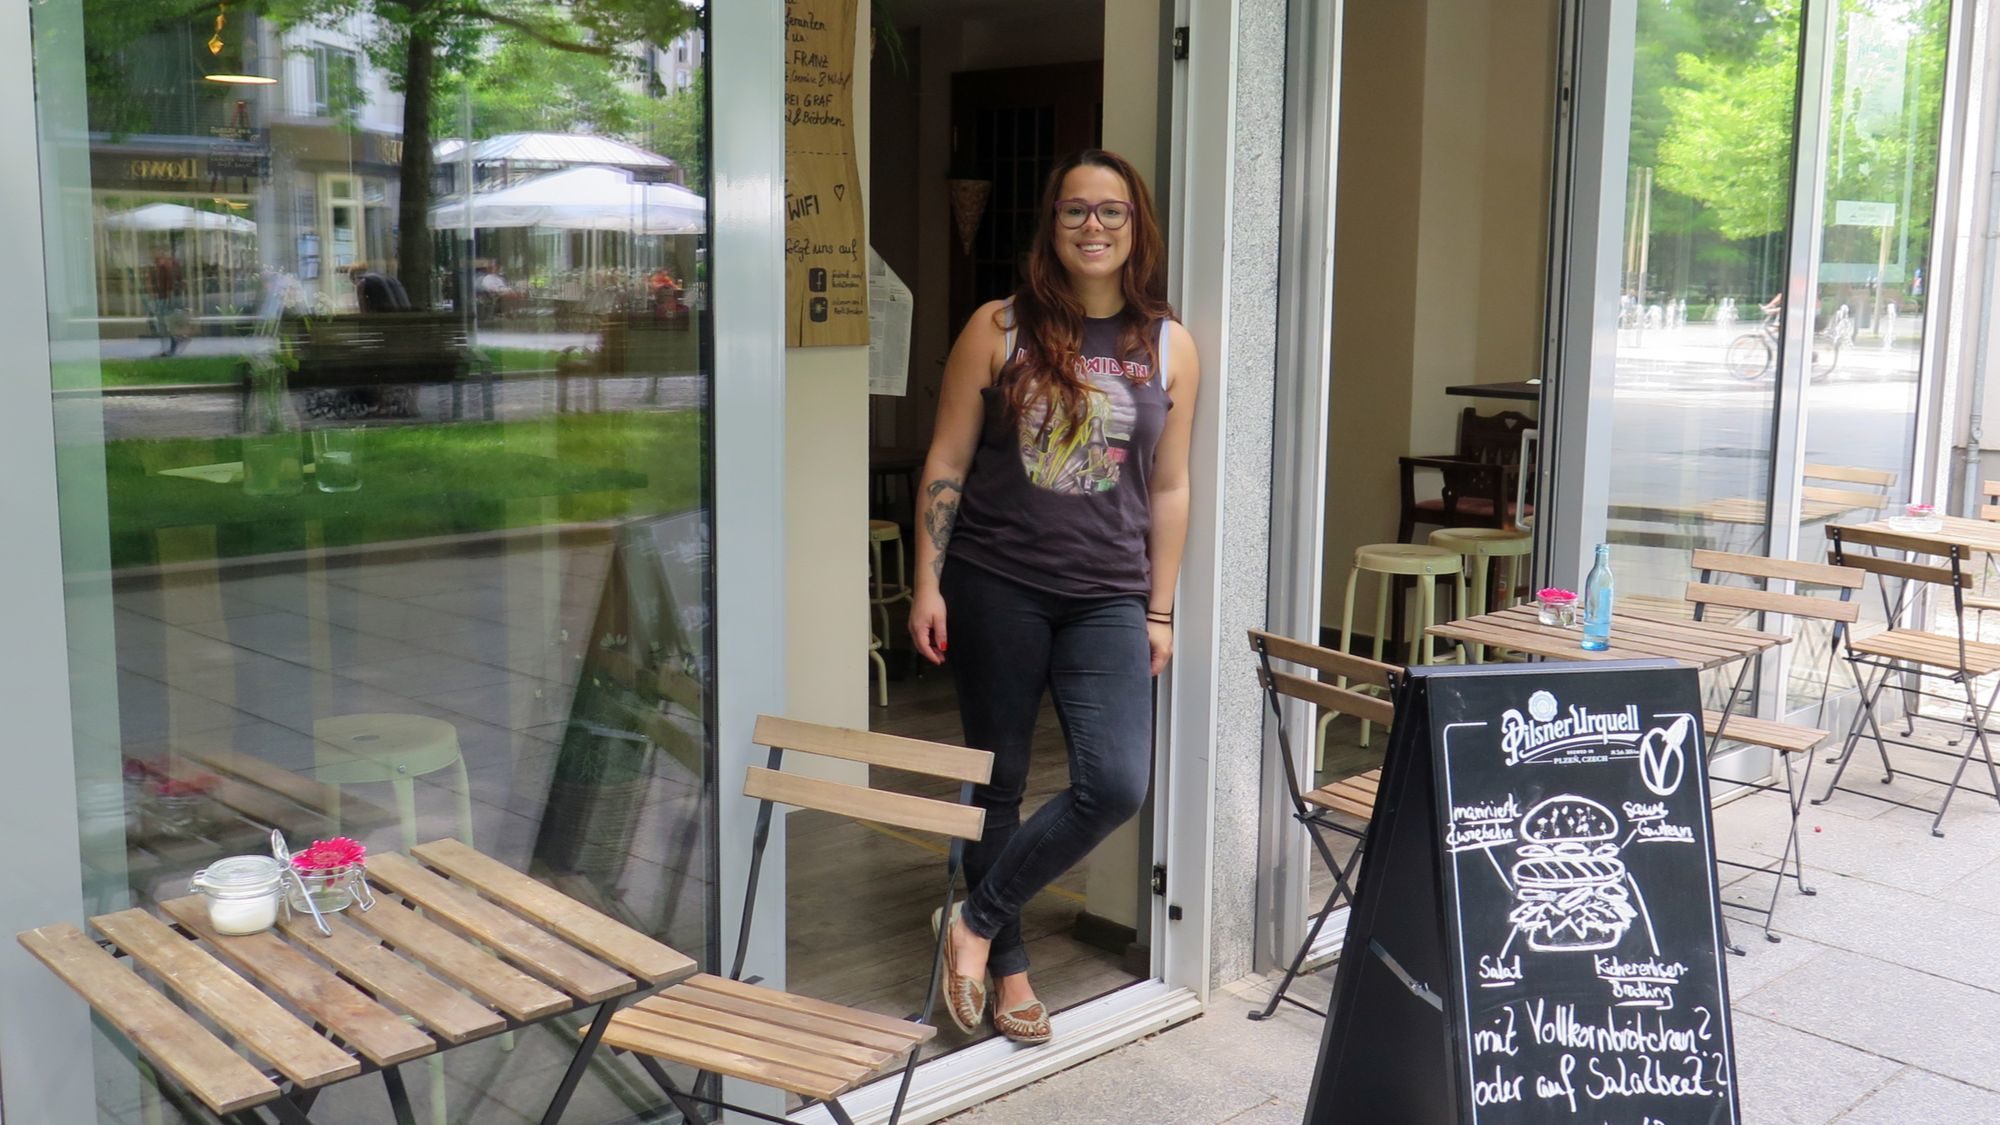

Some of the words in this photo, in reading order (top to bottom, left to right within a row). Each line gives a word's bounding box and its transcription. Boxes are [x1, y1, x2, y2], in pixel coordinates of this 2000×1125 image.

[794, 50, 829, 67] FRANZ
[803, 94, 832, 107] GRAF
[787, 194, 820, 221] WIFI
[812, 243, 833, 255] uns
[839, 238, 858, 262] auf
[1501, 708, 1573, 767] Pilsner
[1569, 704, 1640, 745] Urquell
[1581, 755, 1608, 763] CZECH
[1474, 1005, 1519, 1056] mit
[1475, 1065, 1525, 1106] oder
[1536, 1054, 1577, 1112] auf
